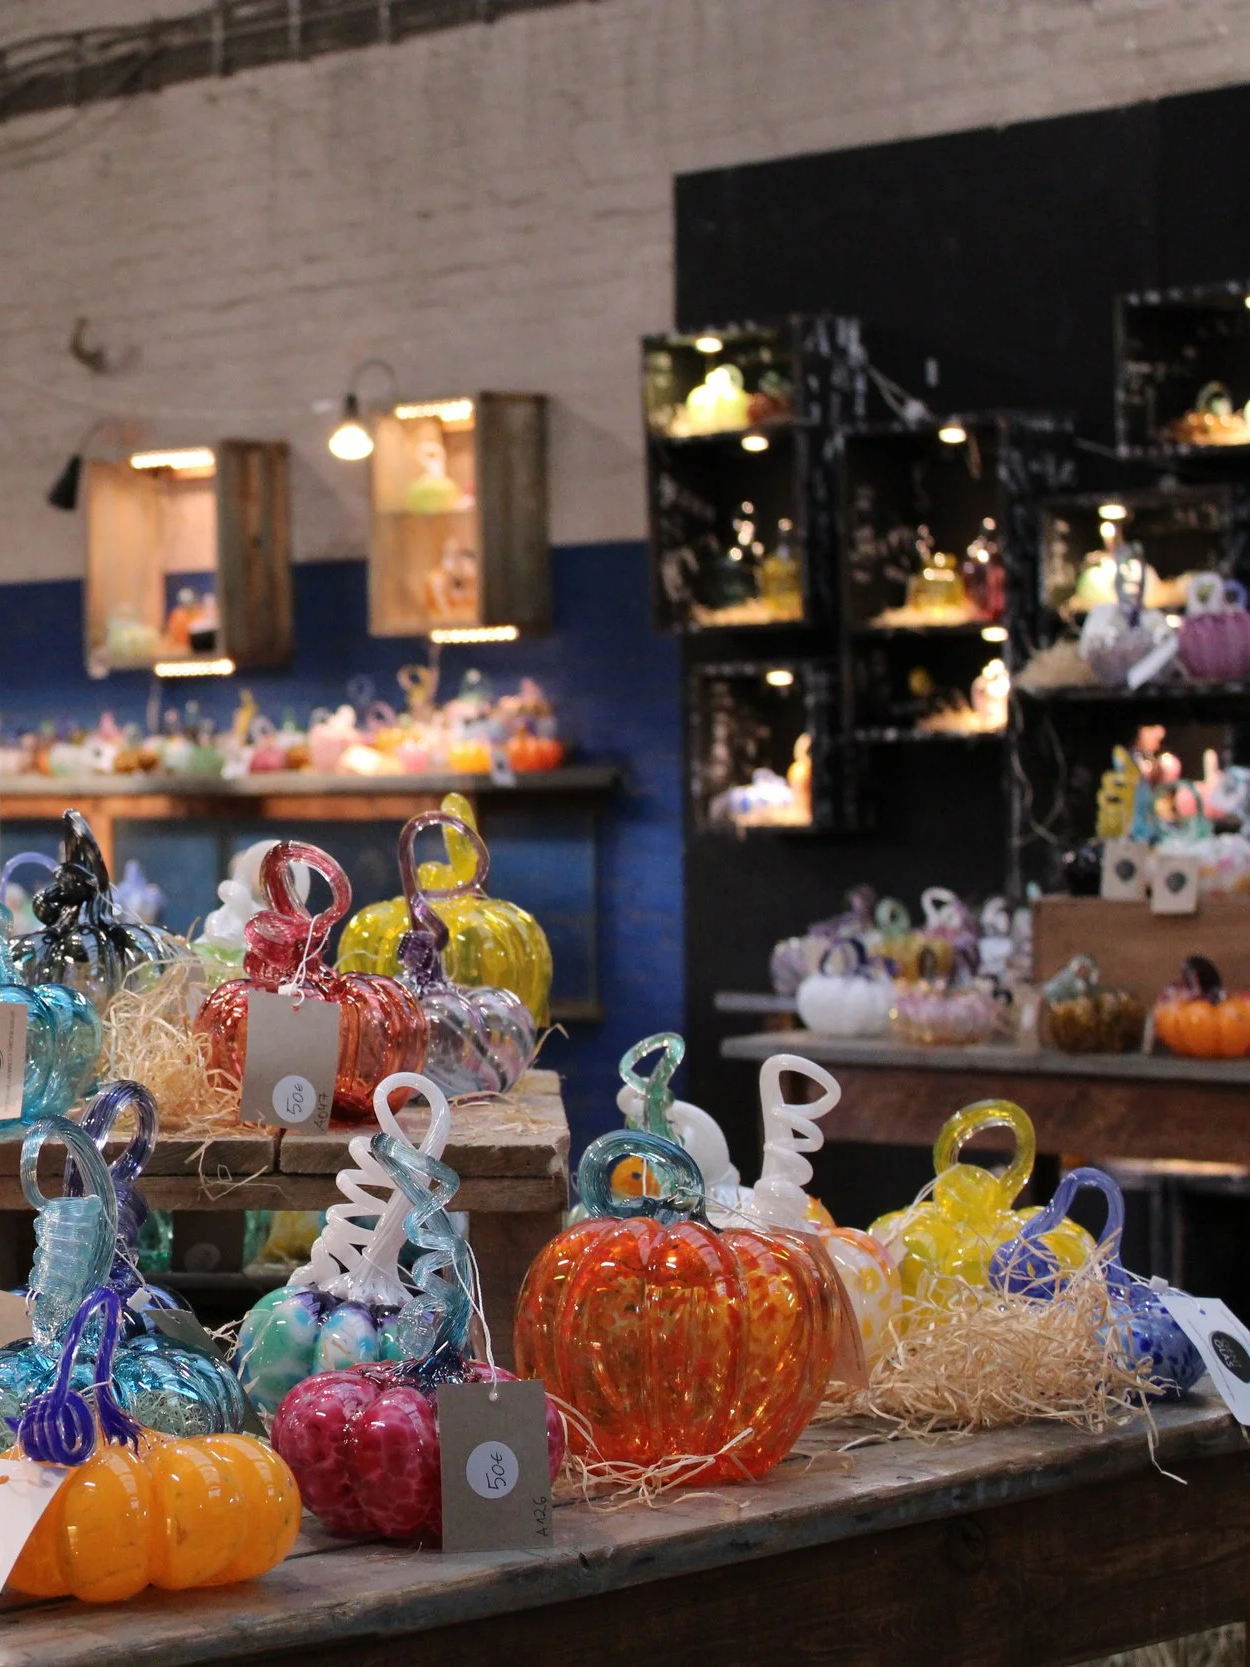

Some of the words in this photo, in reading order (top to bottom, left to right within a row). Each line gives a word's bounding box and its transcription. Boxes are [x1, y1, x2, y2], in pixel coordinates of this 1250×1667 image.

[286, 1083, 304, 1116] 50€
[1213, 1338, 1235, 1368] GLAS
[486, 1451, 507, 1490] 50€
[533, 1496, 549, 1537] A126
